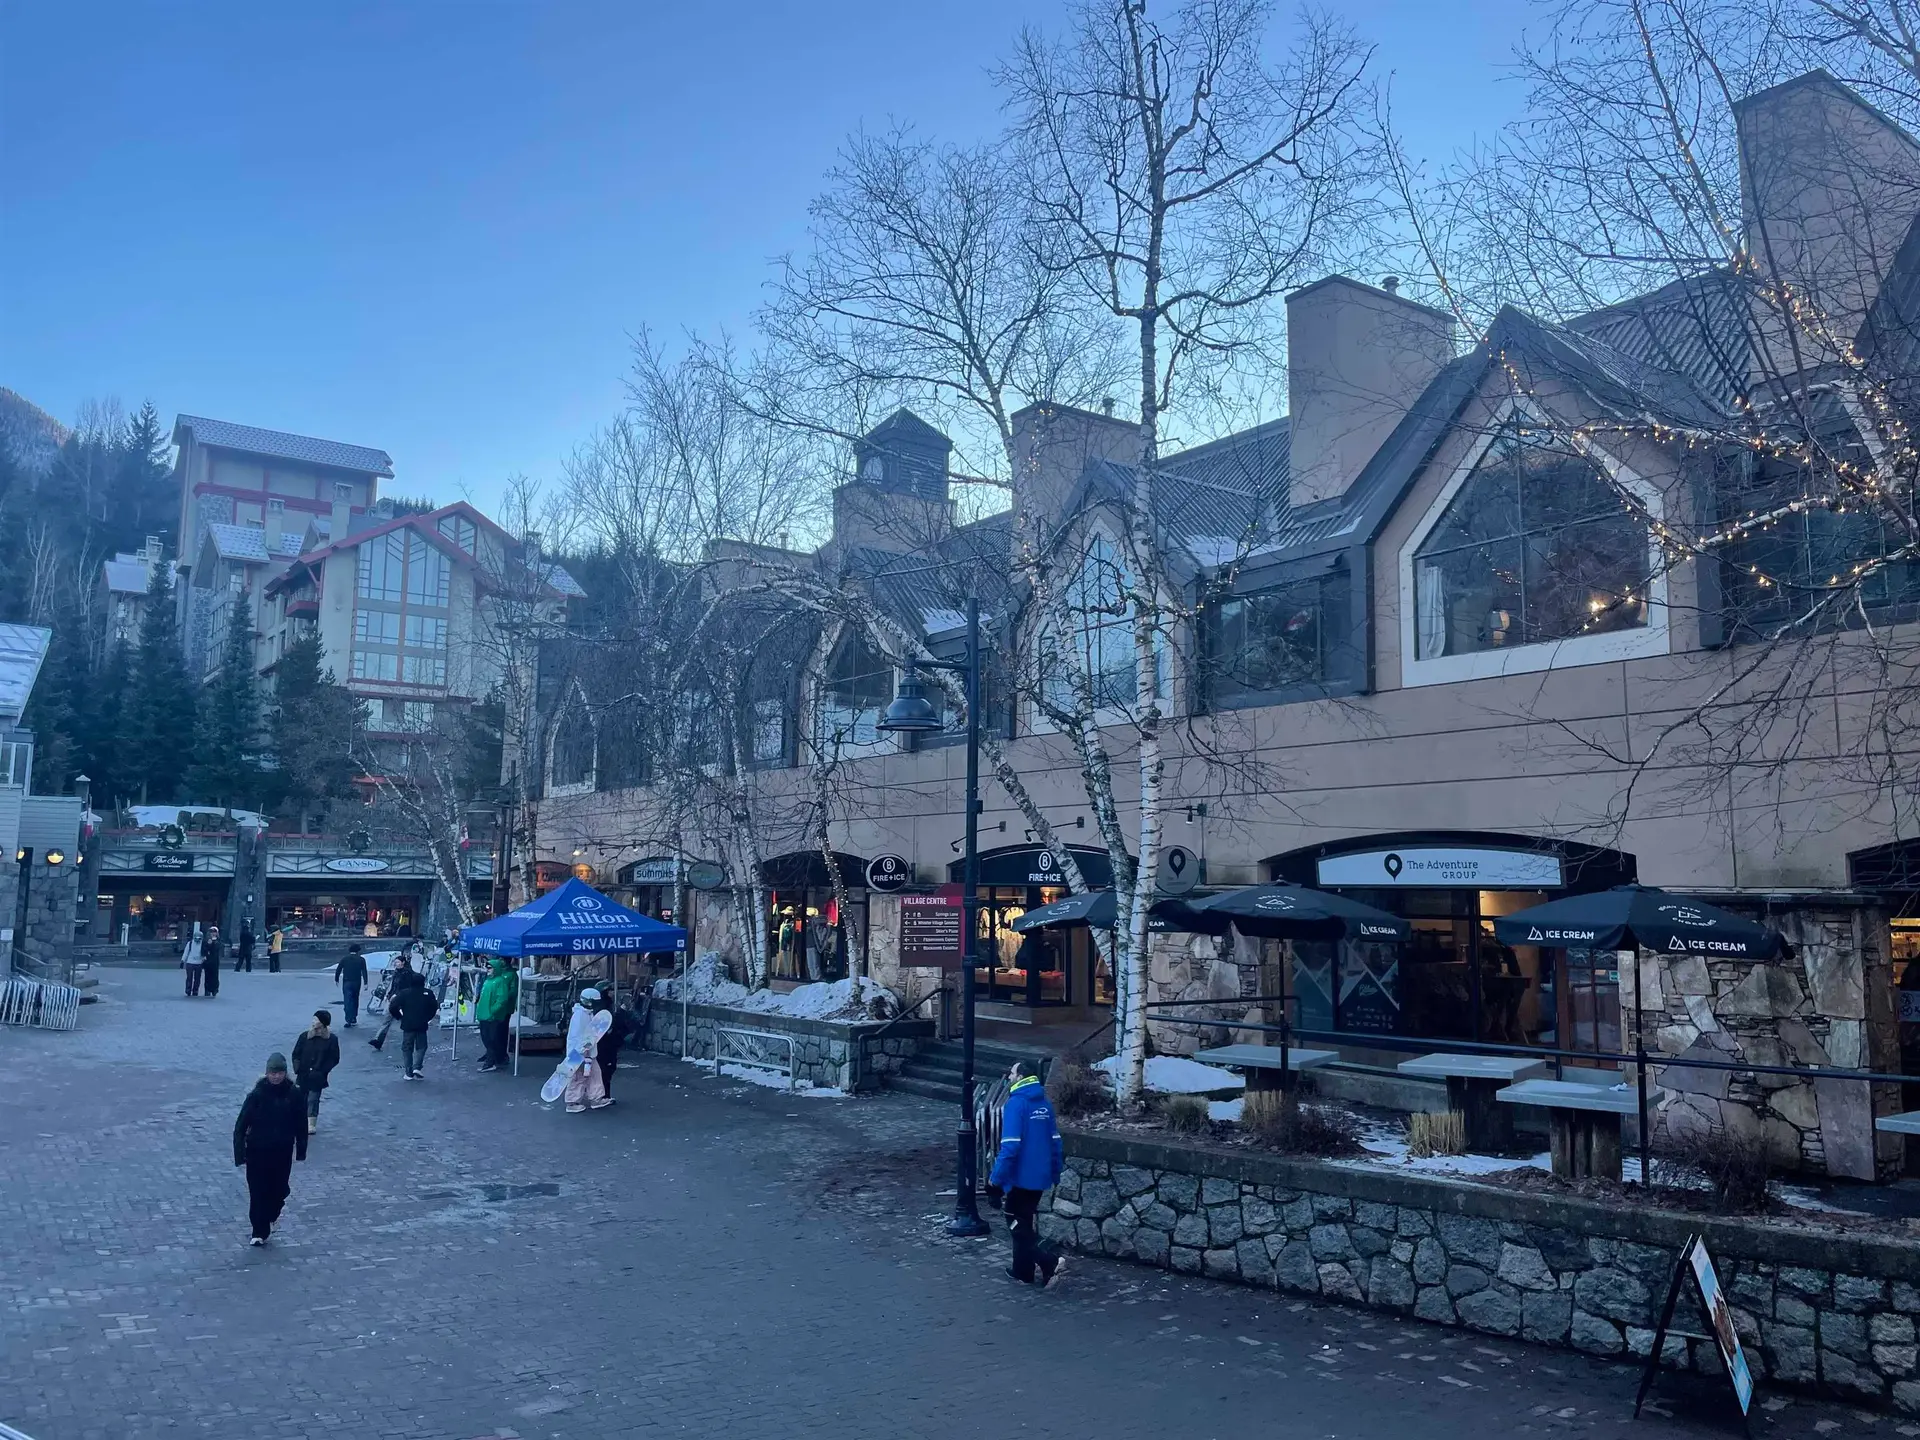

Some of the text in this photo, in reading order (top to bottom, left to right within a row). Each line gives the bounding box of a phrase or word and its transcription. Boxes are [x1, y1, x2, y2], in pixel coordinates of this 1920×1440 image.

[1407, 860, 1478, 869] The Adventure
[1442, 871, 1477, 879] GROUP
[903, 897, 947, 905] VILLAGE CENTRE
[557, 912, 631, 925] Hilton
[1378, 927, 1397, 935] CREAM
[1546, 930, 1595, 940] ICE CREAM
[473, 937, 484, 949] SKI
[484, 938, 501, 950] VALET
[572, 937, 642, 950] SKI VALET
[1688, 940, 1746, 952] ICE CREAM
